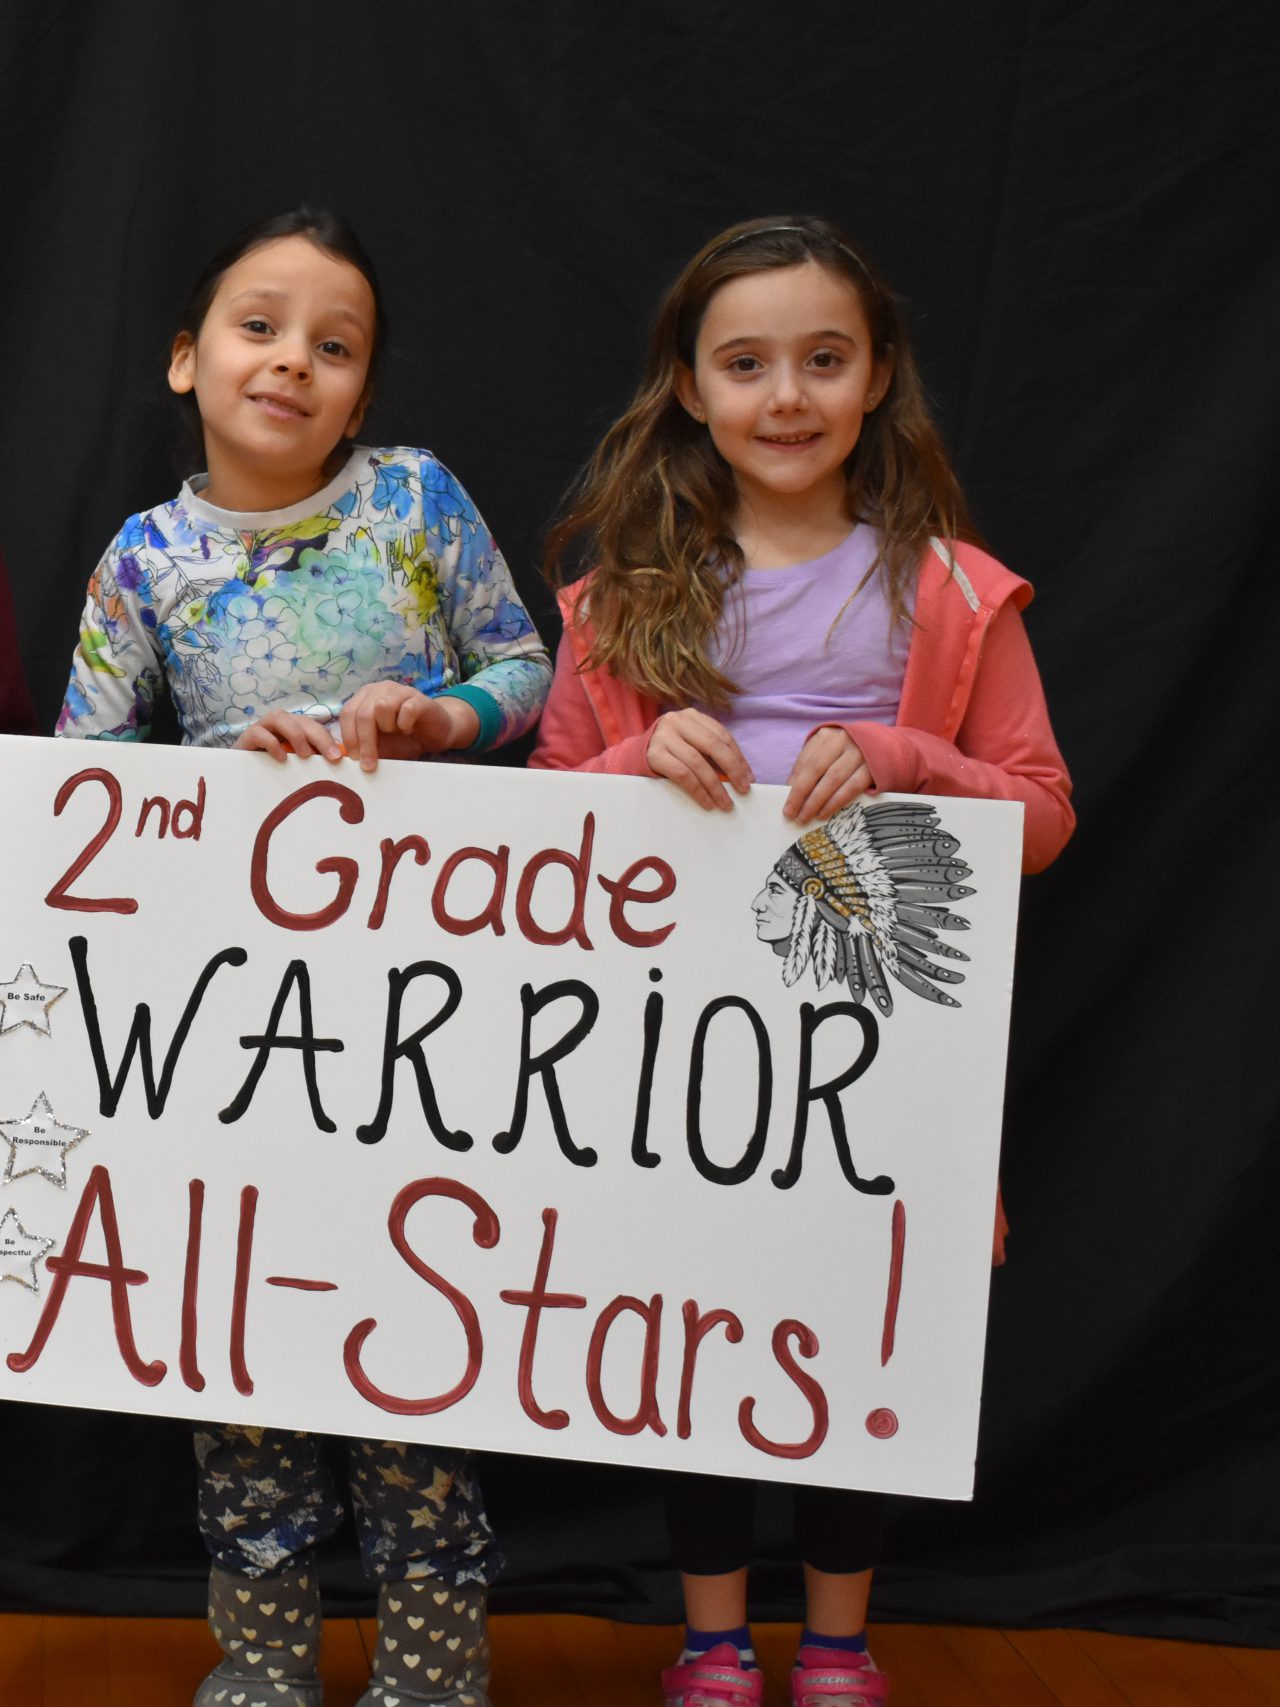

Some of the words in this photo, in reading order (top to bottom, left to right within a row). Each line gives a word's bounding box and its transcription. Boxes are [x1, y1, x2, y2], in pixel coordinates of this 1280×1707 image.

[45, 767, 207, 915] 2nd
[250, 779, 677, 951] Grade
[7, 992, 21, 1001] Be
[23, 992, 46, 1002] Safe
[34, 1126, 46, 1134] Be
[12, 1136, 67, 1148] Responsible
[4, 1238, 16, 1246] Be
